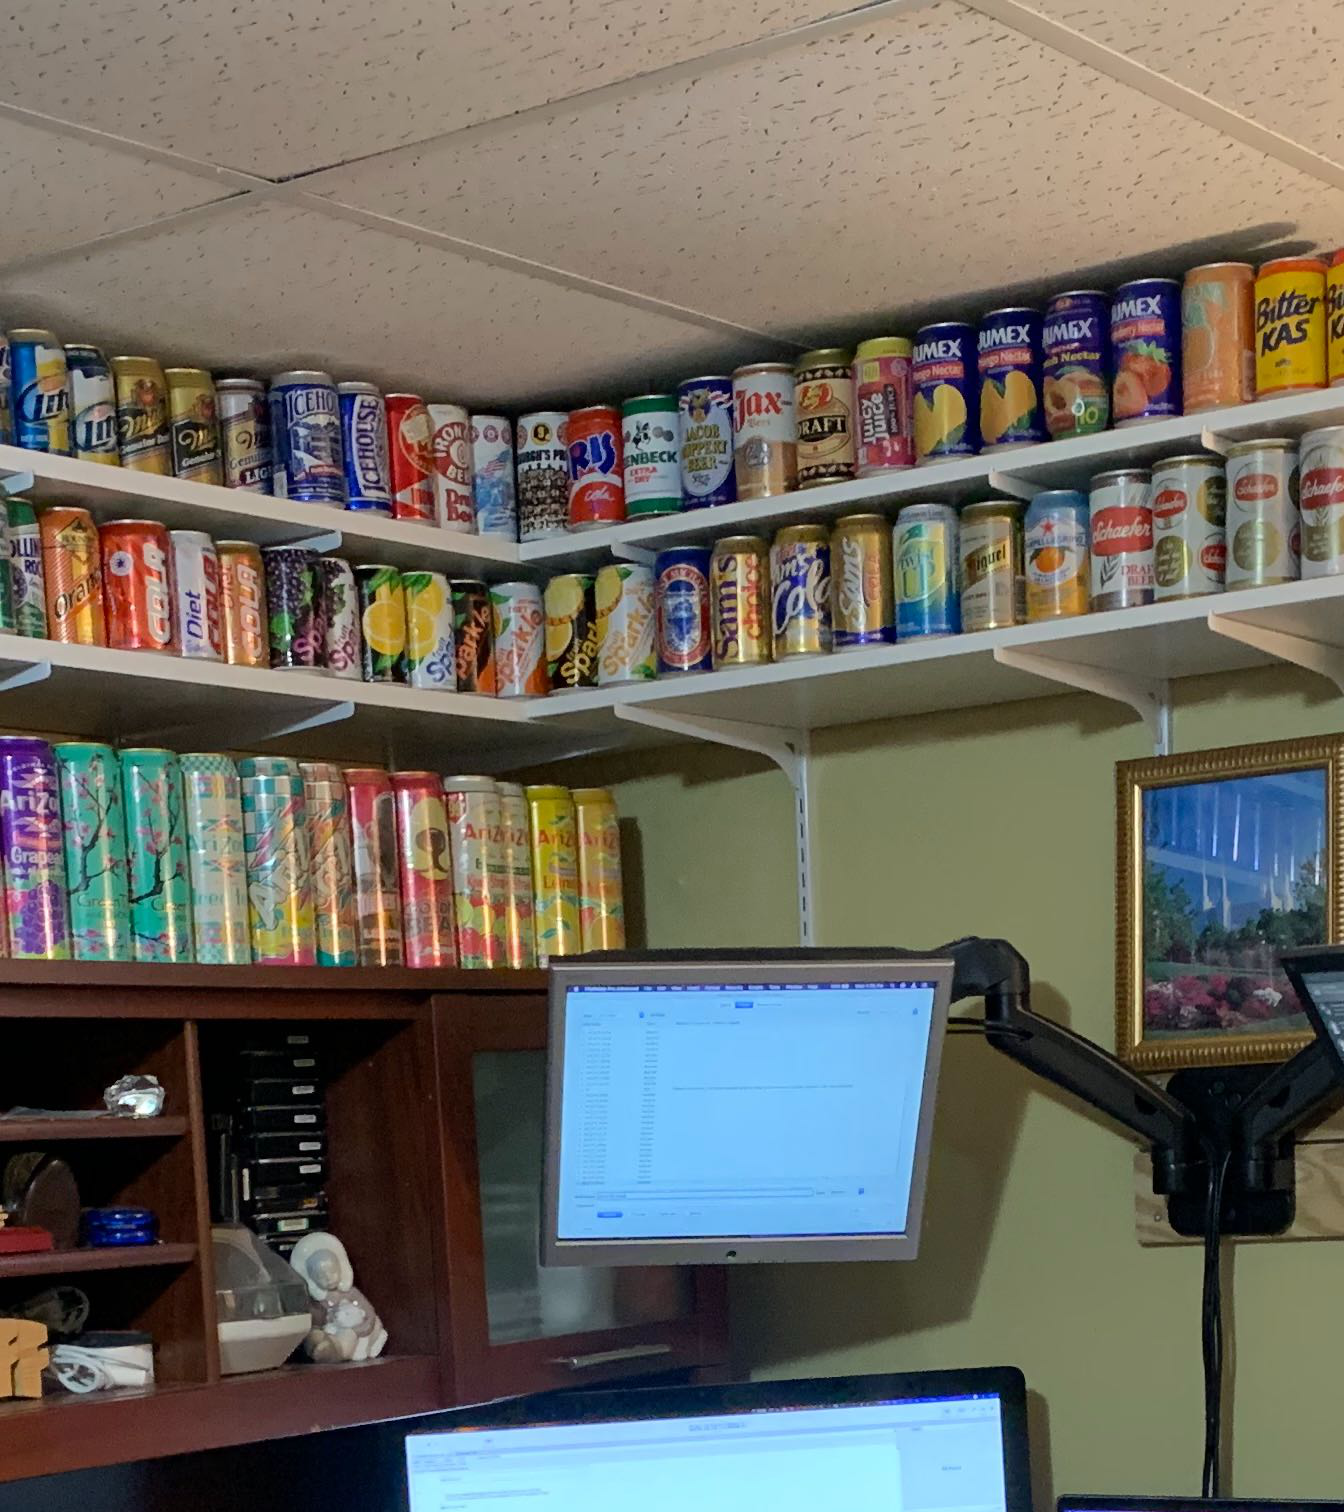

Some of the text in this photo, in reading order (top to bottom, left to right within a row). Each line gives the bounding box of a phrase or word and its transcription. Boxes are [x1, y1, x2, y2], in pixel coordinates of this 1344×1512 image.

[1256, 289, 1322, 334] Bitter
[978, 324, 1032, 352] JUMEX
[1261, 317, 1310, 358] KAS
[735, 389, 783, 434] Jax
[355, 398, 387, 498] ICEHOUSE
[1093, 516, 1153, 543] Schaefer
[142, 543, 171, 645] COLA
[741, 555, 762, 641] choice
[185, 590, 205, 645] Diet
